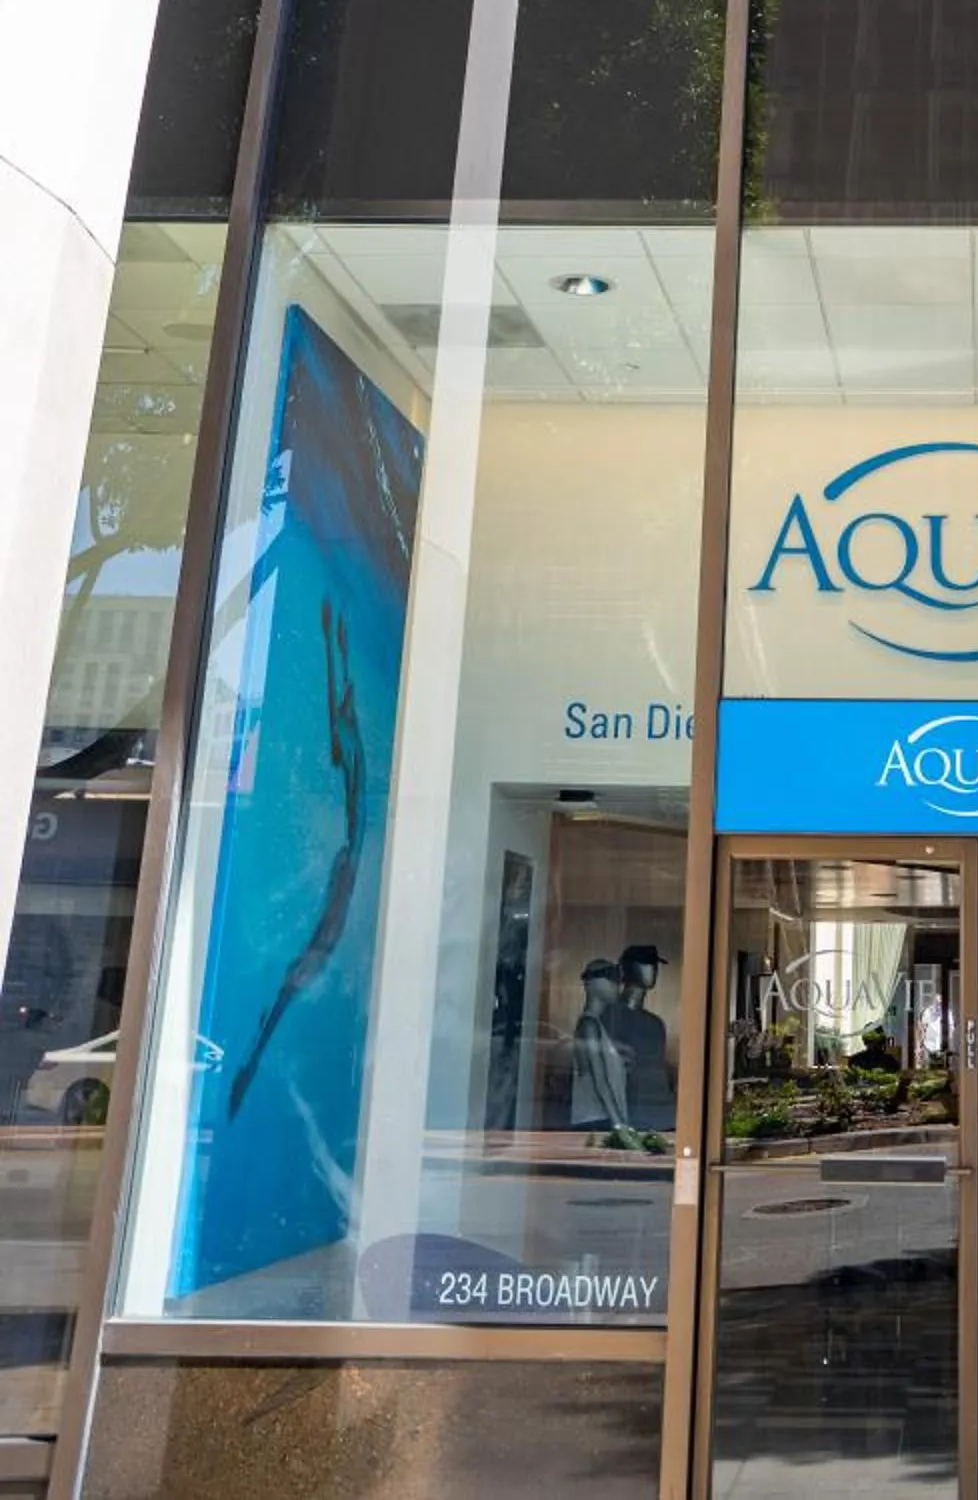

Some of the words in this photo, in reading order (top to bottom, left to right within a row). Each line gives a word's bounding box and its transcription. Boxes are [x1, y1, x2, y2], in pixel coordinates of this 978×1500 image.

[565, 702, 632, 739] San
[439, 1271, 488, 1305] 234
[497, 1272, 658, 1309] BROADWAY
